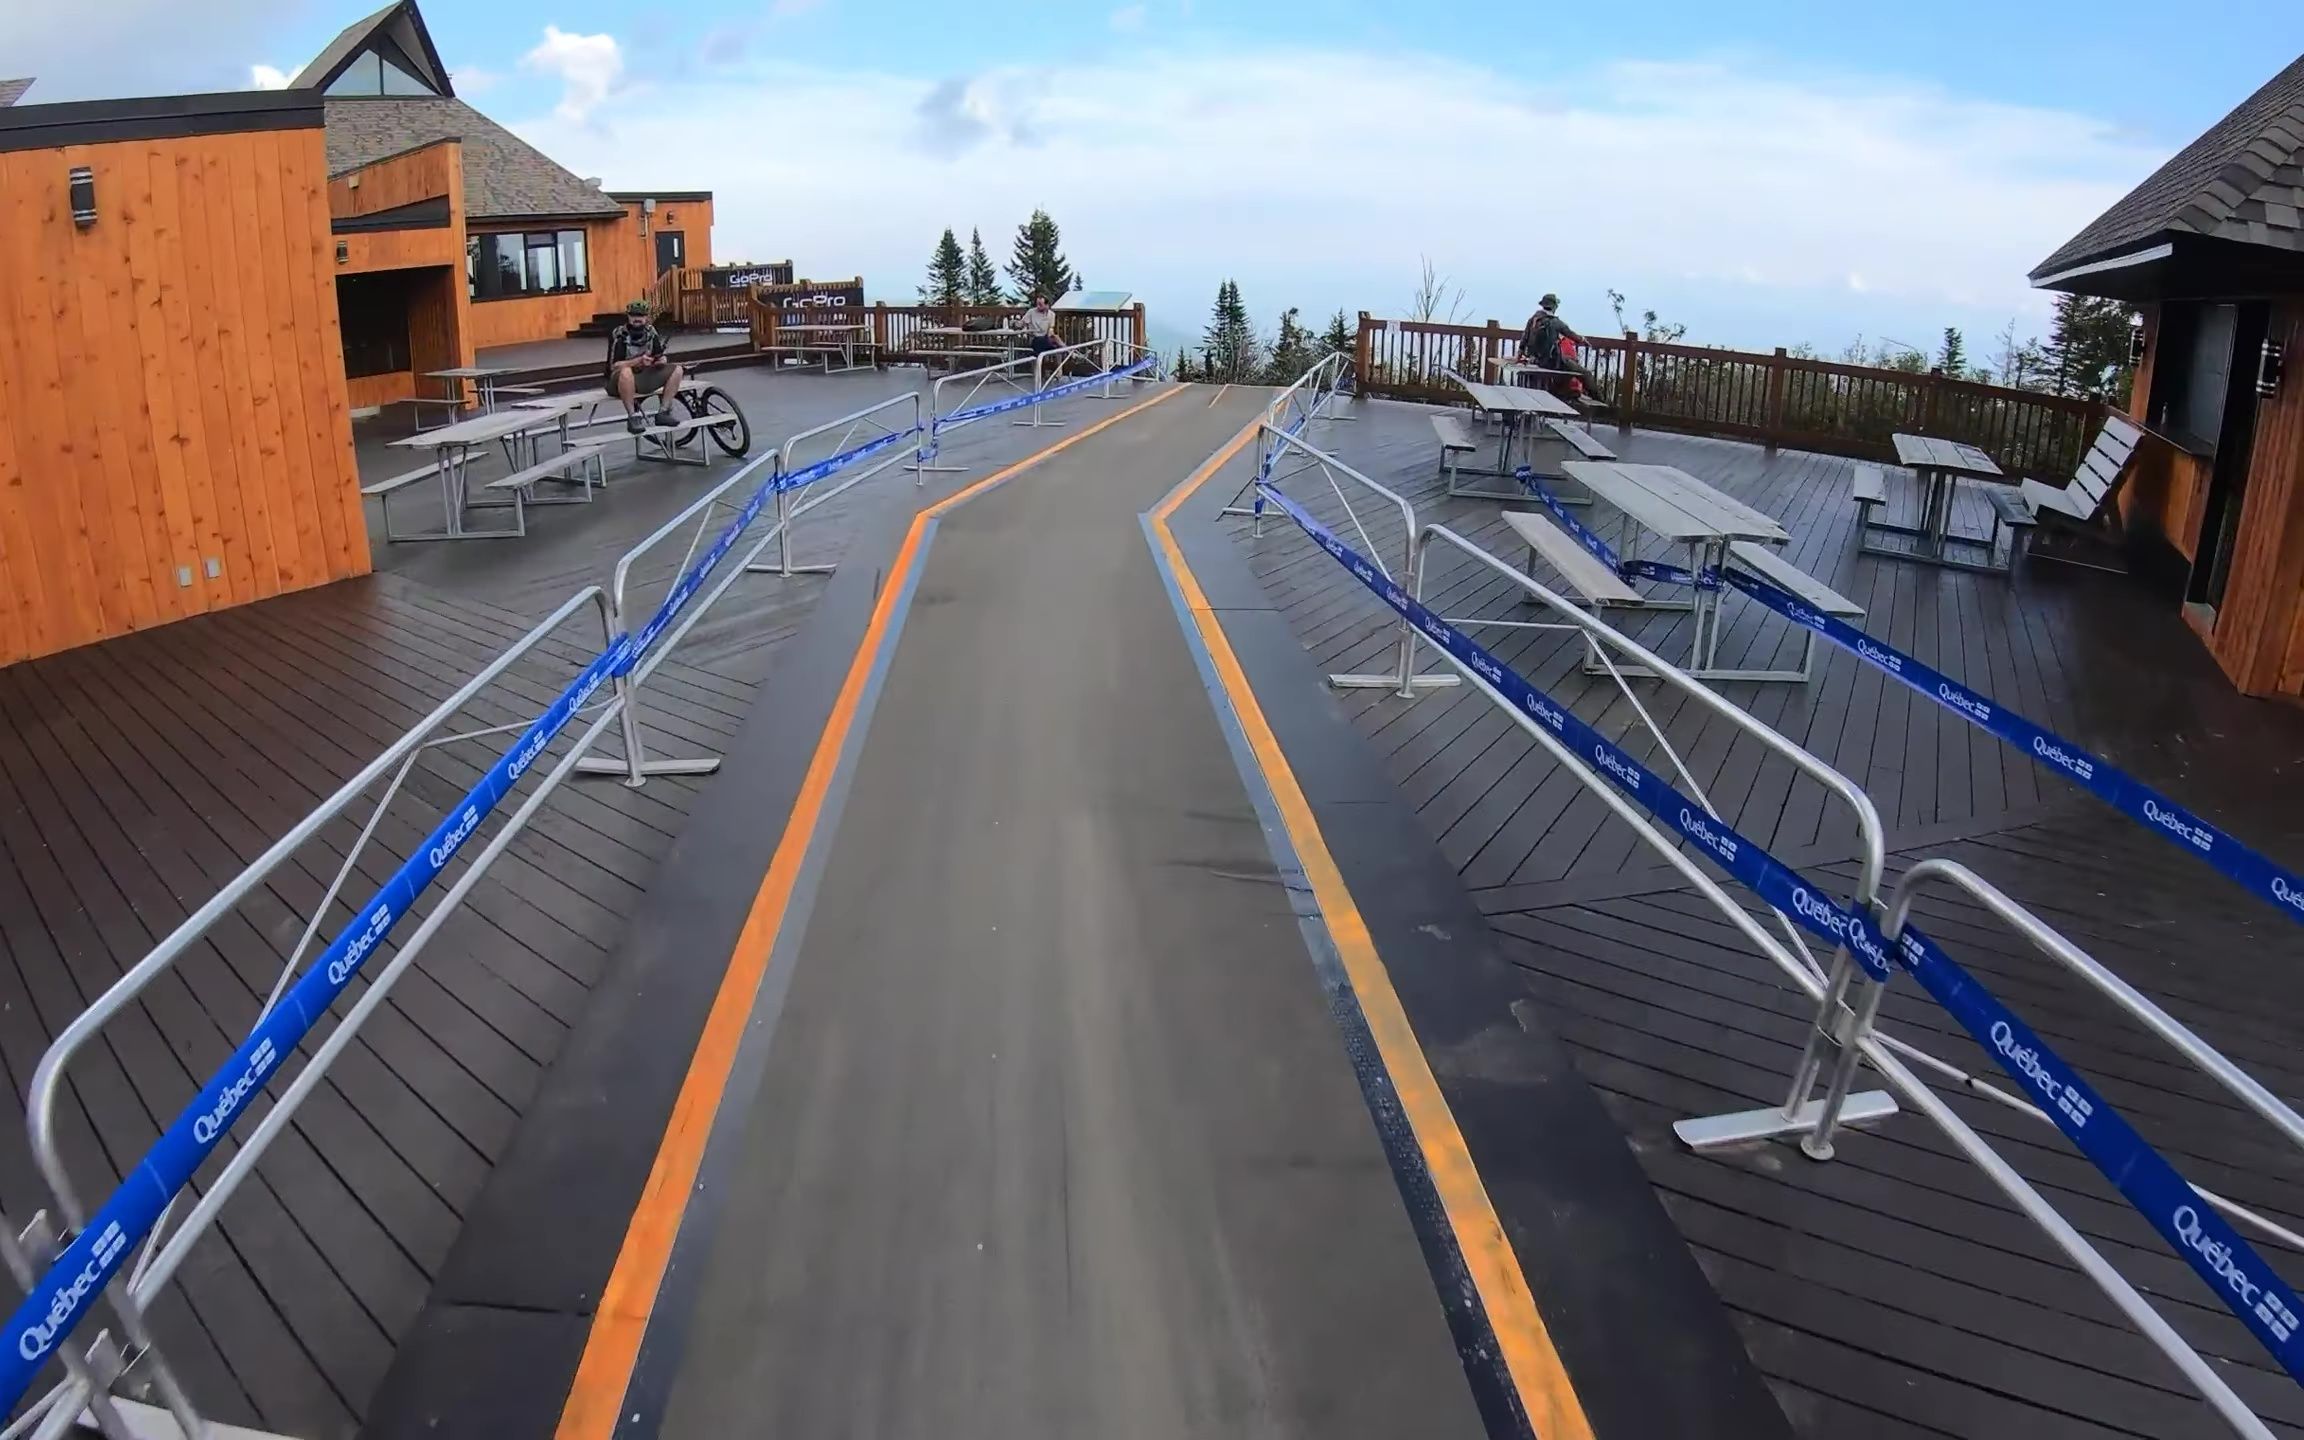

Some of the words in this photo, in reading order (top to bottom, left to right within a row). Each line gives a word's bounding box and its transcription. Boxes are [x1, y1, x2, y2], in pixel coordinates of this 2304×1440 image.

[1858, 639, 1890, 664] Québec
[1527, 693, 1553, 725] Québec
[1938, 682, 1975, 716] Québec
[1595, 744, 1628, 782] Québec
[2032, 735, 2077, 774] Québec
[1679, 808, 1720, 850] Québec
[2142, 799, 2194, 843] Québec
[429, 823, 467, 869] Québec
[1792, 887, 1848, 937] Québec
[327, 927, 376, 986] Québec
[1990, 1021, 2063, 1100] Québec
[193, 1066, 258, 1146] Québec
[2172, 1205, 2261, 1309] Québec
[20, 1260, 102, 1362] Québec
